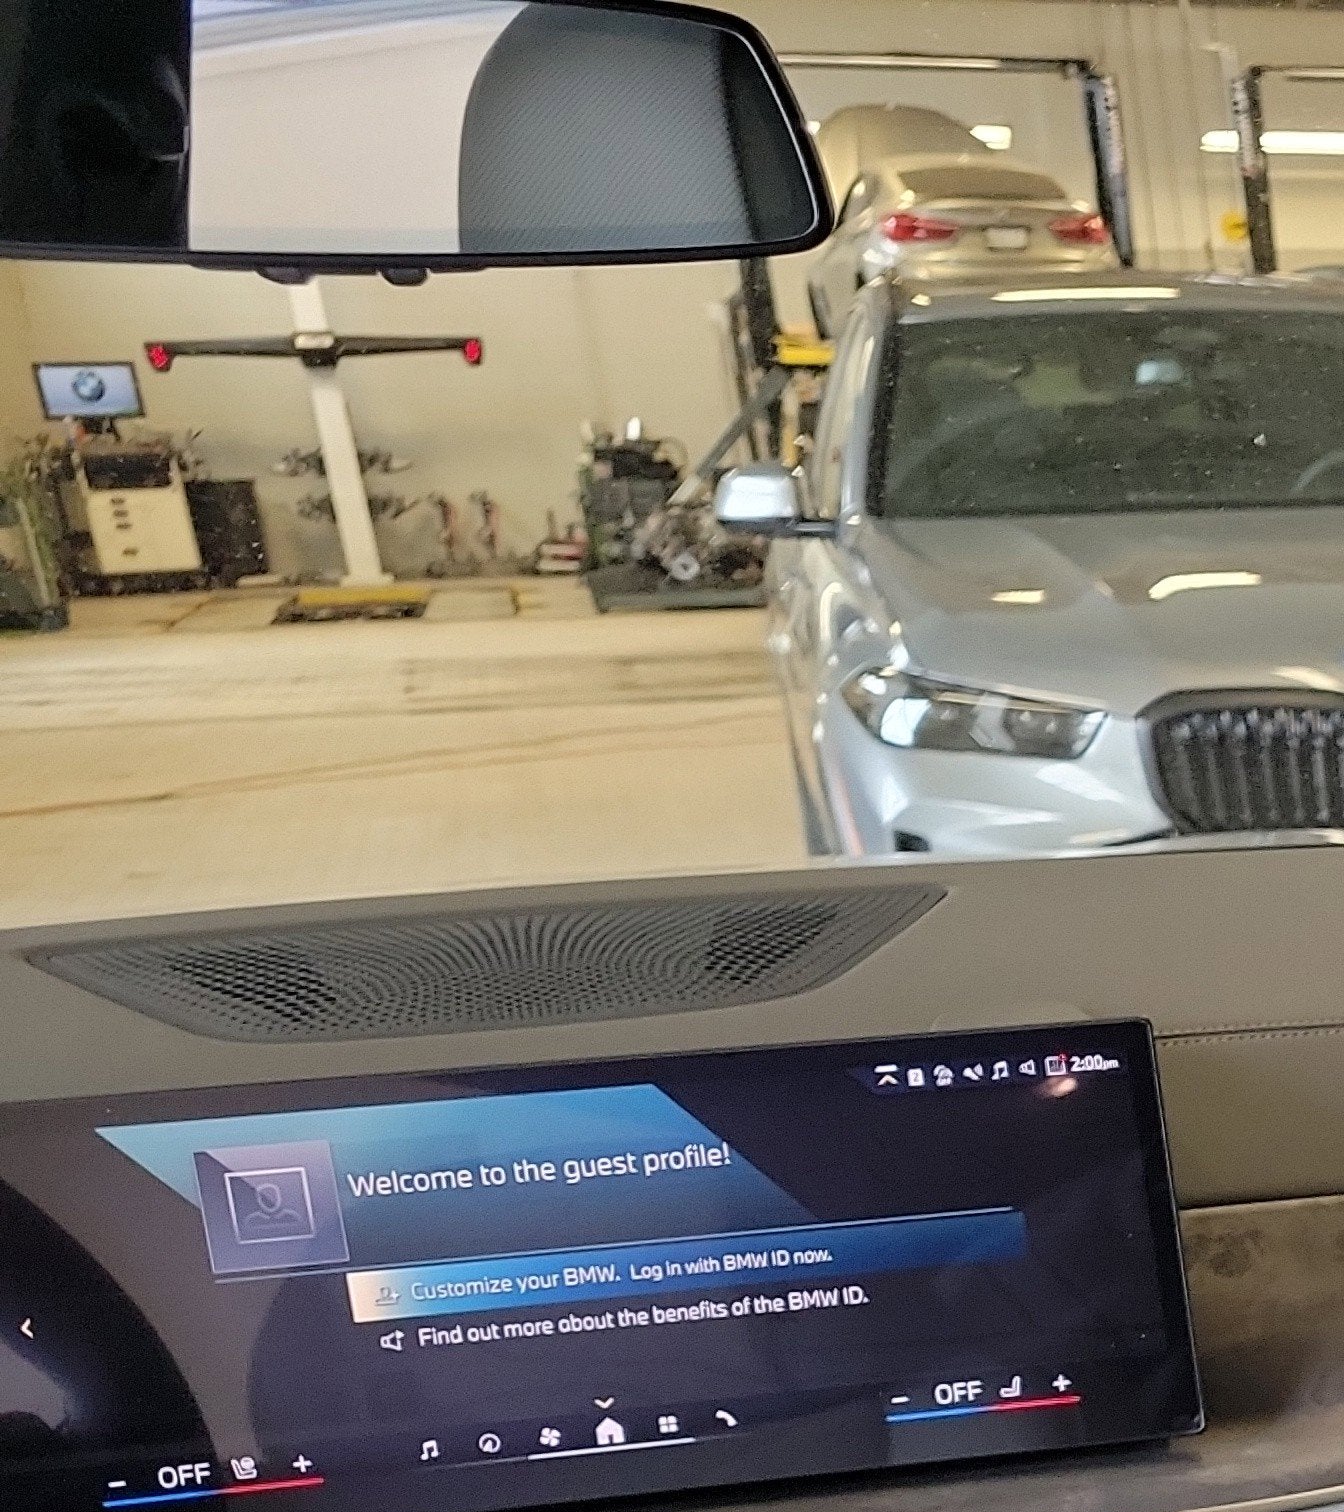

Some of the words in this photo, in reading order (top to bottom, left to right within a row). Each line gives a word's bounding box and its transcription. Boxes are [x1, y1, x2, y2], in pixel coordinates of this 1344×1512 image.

[347, 1169, 473, 1197] Welcome
[479, 1164, 506, 1186] to
[512, 1158, 556, 1184] the
[563, 1152, 638, 1184] guest
[643, 1141, 732, 1177] profile!
[411, 1276, 513, 1301] Customize
[515, 1272, 560, 1294] your
[562, 1263, 621, 1287] BMW.
[629, 1263, 664, 1282] Log
[665, 1260, 682, 1277] in
[683, 1256, 721, 1275] with
[722, 1251, 769, 1272] BMW
[771, 1249, 790, 1267] ID
[792, 1249, 833, 1265] now.
[417, 1324, 464, 1347] Find
[466, 1323, 501, 1343] out
[503, 1319, 555, 1339] more
[558, 1313, 616, 1334] about
[616, 1307, 650, 1327] the
[651, 1300, 730, 1325] benefits
[730, 1295, 751, 1317] of
[753, 1294, 785, 1315] the
[787, 1287, 839, 1312] BMW
[841, 1284, 871, 1306] ID.
[934, 1380, 983, 1405] OFF
[156, 1461, 211, 1489] OFF
